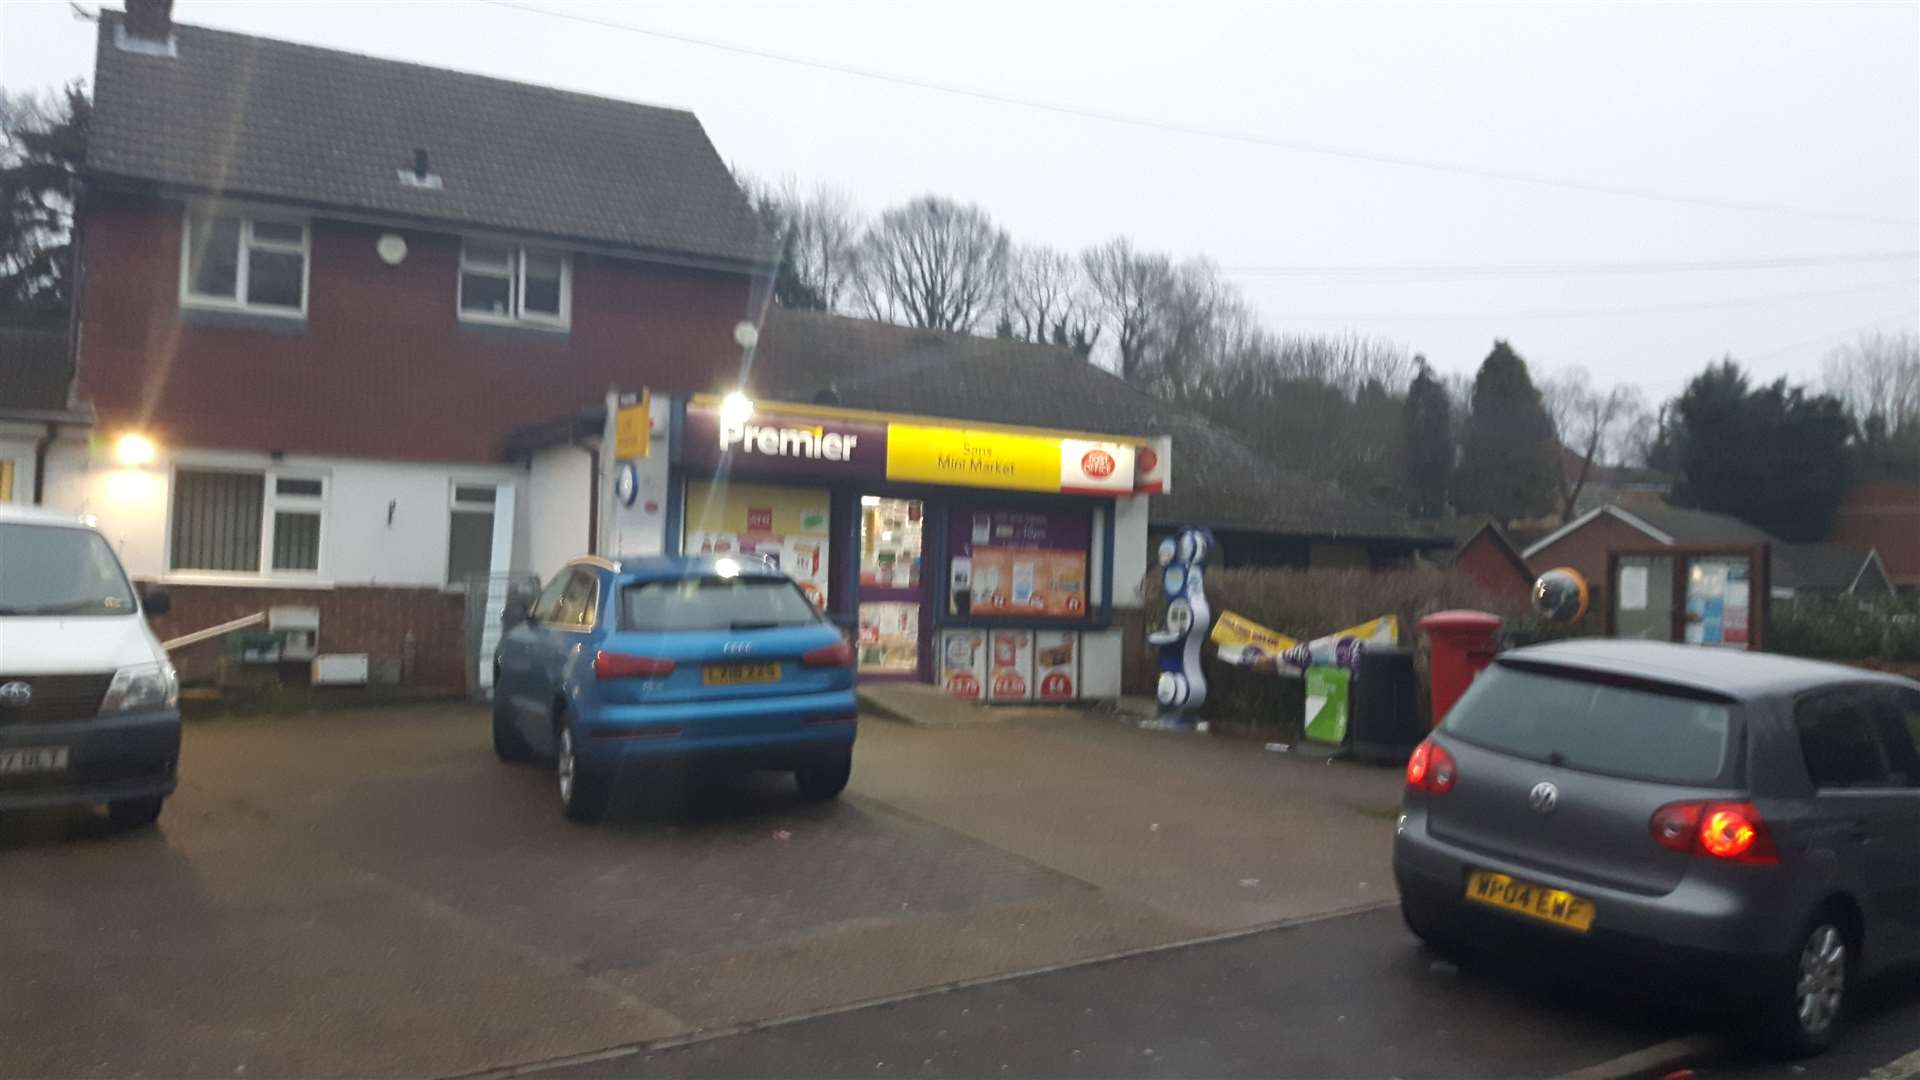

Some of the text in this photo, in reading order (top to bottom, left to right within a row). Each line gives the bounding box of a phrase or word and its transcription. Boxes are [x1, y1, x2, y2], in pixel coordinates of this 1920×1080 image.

[719, 412, 857, 461] Premier
[937, 456, 1014, 476] Mini Market
